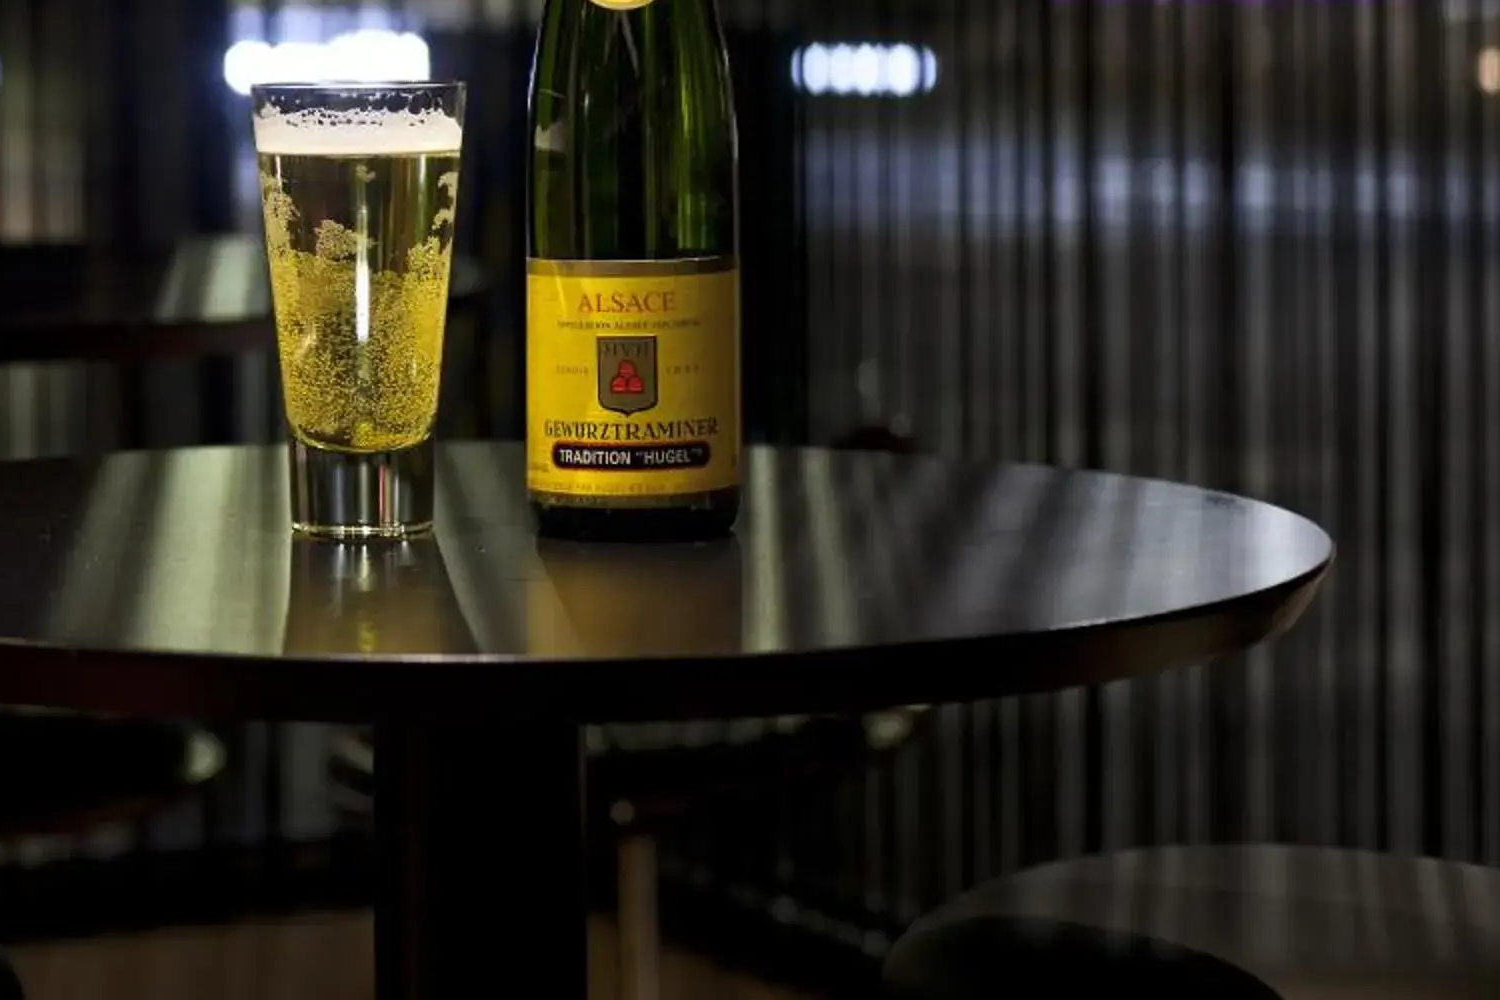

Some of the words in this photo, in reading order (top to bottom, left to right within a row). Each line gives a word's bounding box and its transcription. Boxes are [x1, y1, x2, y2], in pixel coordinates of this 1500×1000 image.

[578, 291, 677, 313] ALSACE
[545, 417, 718, 441] GEWURZTRAMINER
[559, 449, 631, 465] TRADITION
